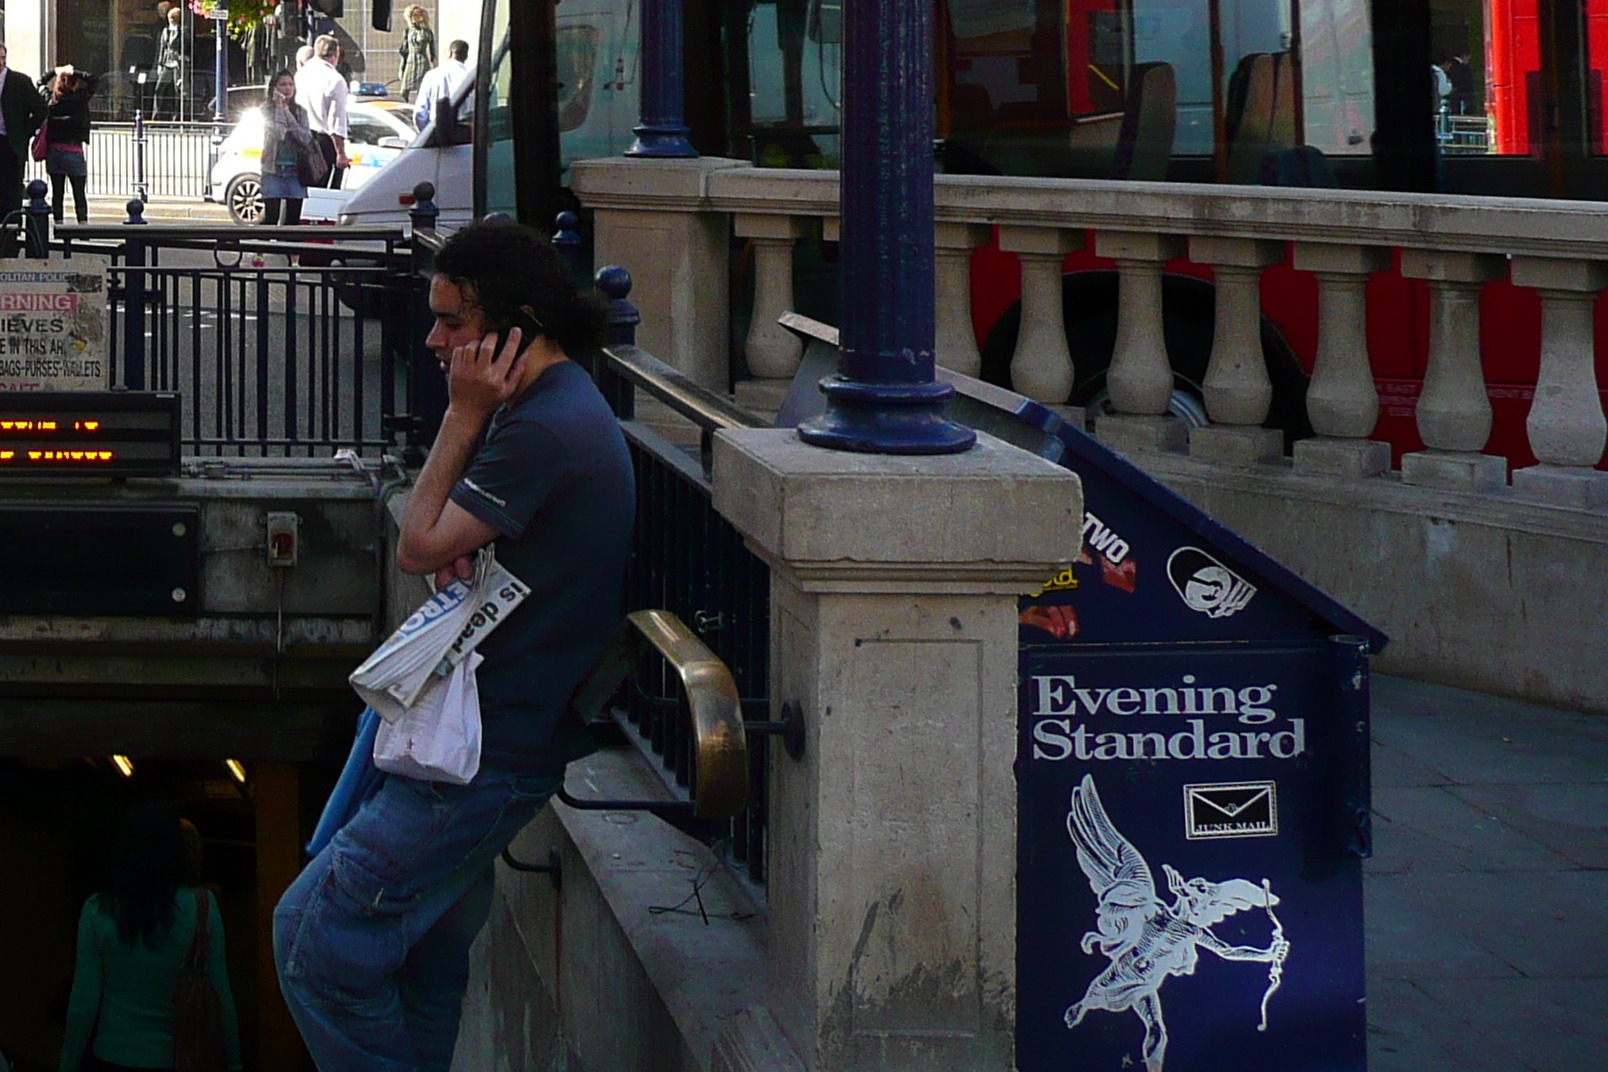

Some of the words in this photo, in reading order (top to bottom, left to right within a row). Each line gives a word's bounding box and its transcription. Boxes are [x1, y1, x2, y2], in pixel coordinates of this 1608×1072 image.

[24, 338, 47, 355] THIS
[1082, 512, 1130, 563] TWO
[400, 579, 472, 634] ETRO
[499, 581, 528, 603] is
[1030, 674, 1278, 725] Evening
[1032, 718, 1305, 761] Standard
[1196, 823, 1234, 833] JUNK
[1234, 821, 1269, 832] MAIL
